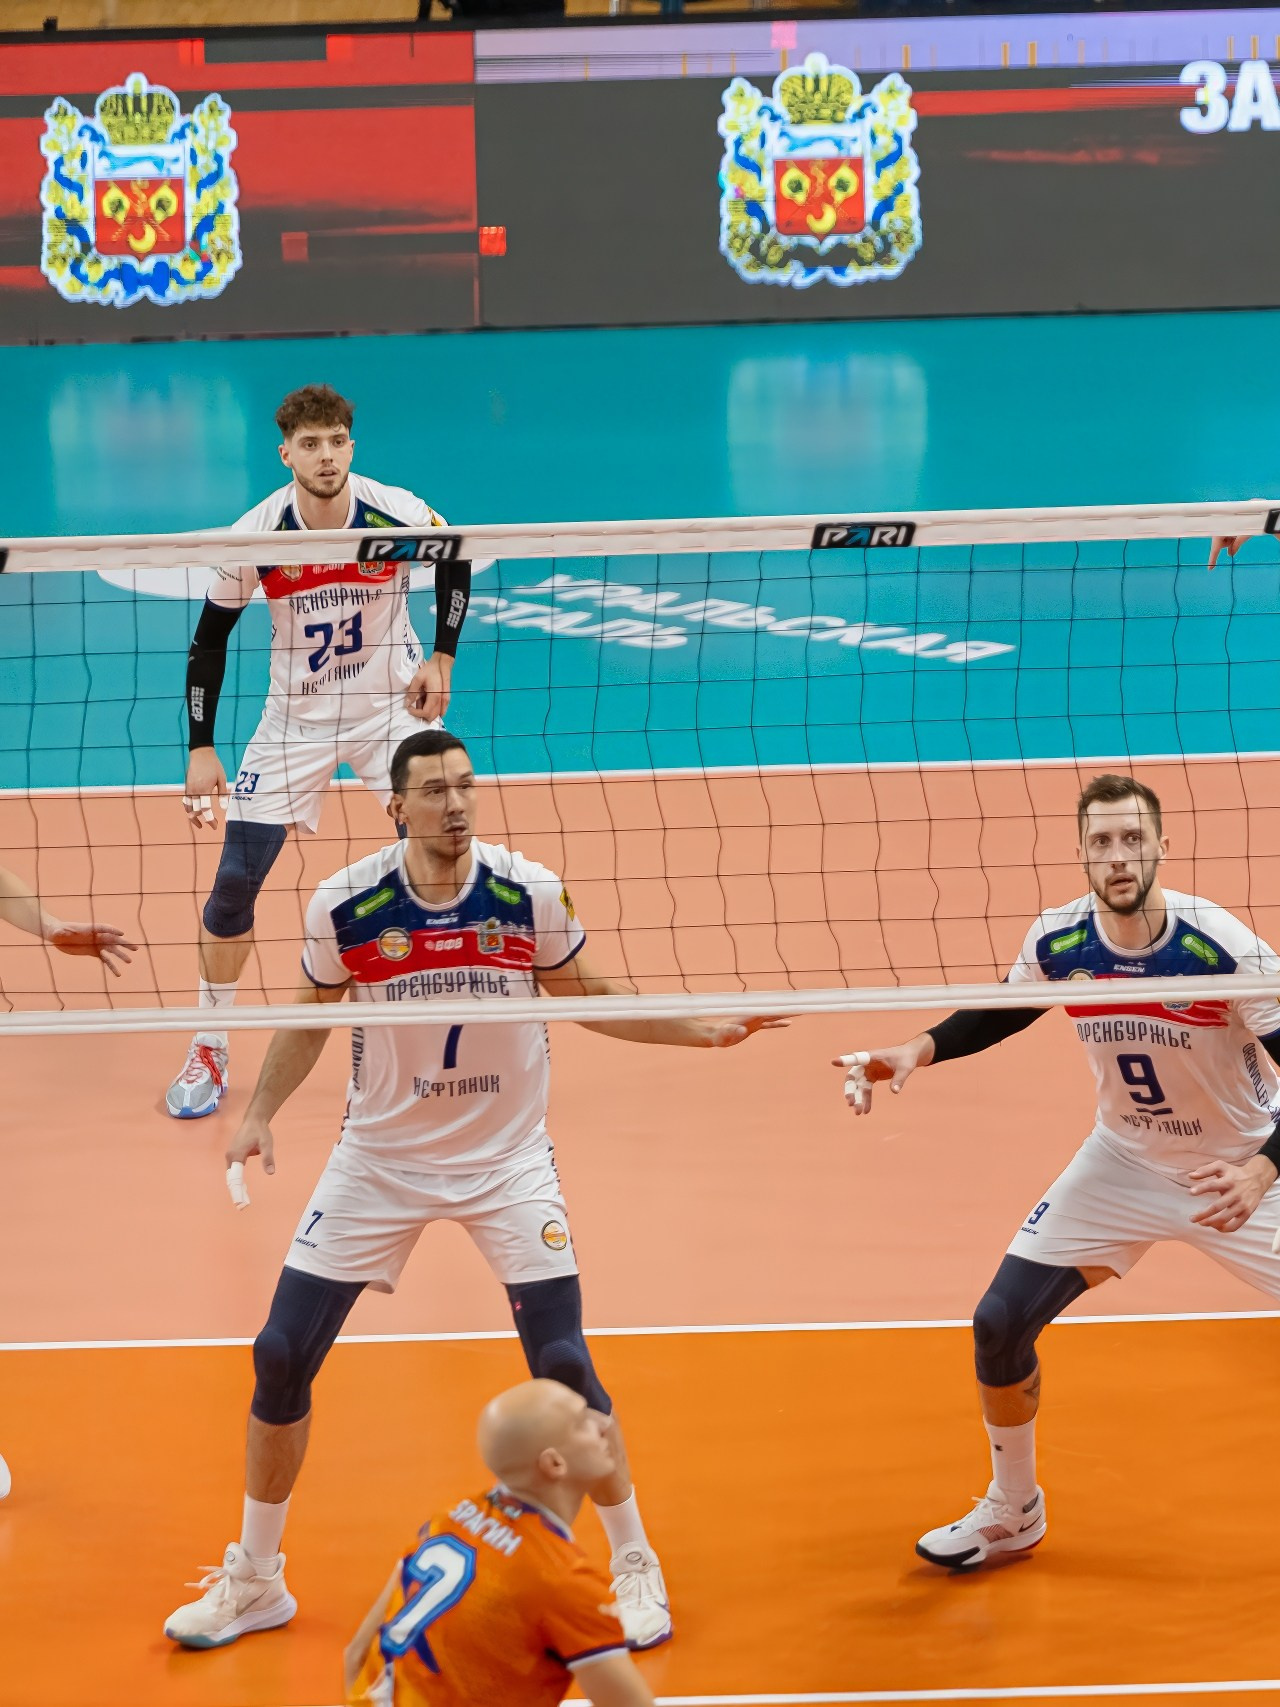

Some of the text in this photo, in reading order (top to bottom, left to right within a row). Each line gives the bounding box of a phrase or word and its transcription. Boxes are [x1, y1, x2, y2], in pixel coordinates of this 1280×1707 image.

[820, 526, 906, 546] PARI
[366, 539, 453, 559] PARI
[512, 573, 1017, 664] УРАЛЬСКАЯ
[304, 610, 363, 673] 23
[235, 771, 260, 793] 23
[1077, 1020, 1192, 1049] ОРЕНБУРЖЬЕ
[413, 1074, 500, 1099] НЕФТЯНИК
[305, 1210, 324, 1235] 7
[1028, 1202, 1050, 1224] 9
